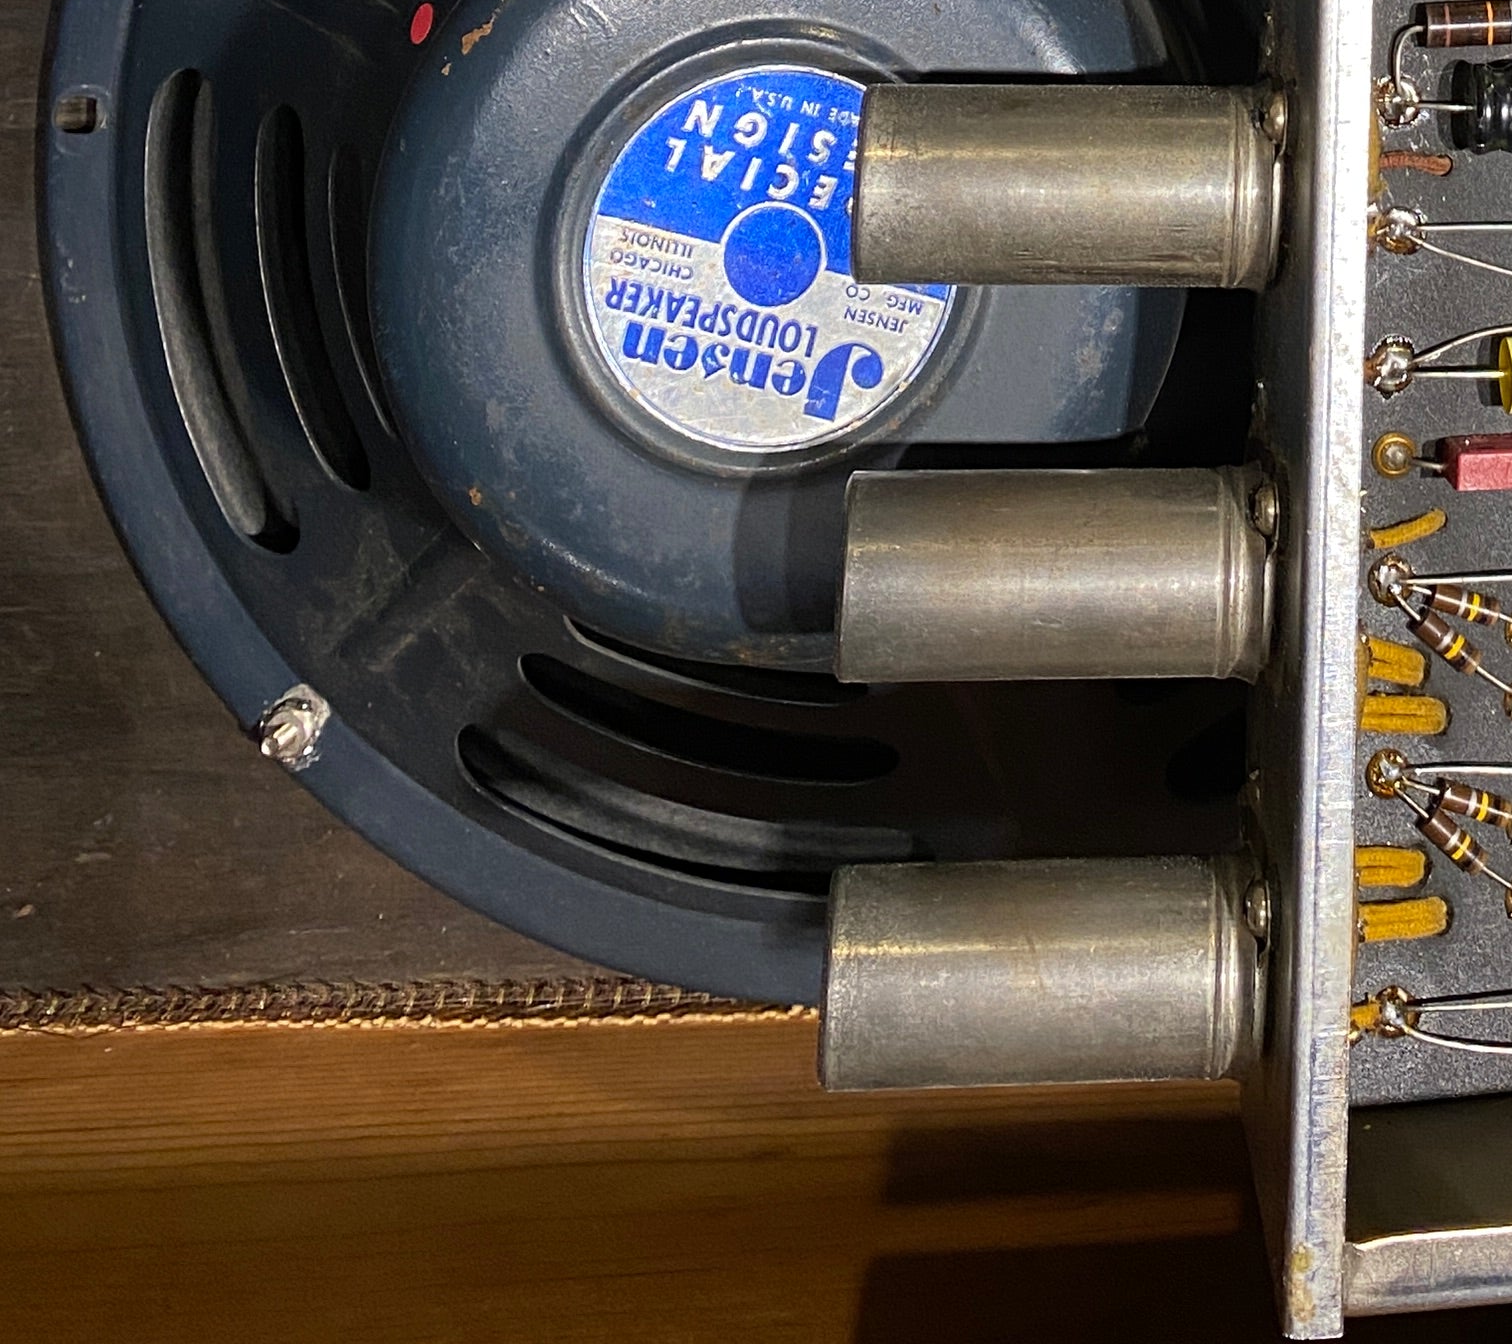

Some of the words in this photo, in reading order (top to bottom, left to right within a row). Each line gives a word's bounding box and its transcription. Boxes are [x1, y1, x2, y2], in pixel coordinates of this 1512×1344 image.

[680, 99, 858, 172] SIGN
[799, 99, 821, 118] IN
[827, 106, 860, 128] ADE
[663, 135, 853, 217] ECIAL
[609, 247, 695, 281] CHICAGO
[618, 225, 695, 259] ILLINOIS
[604, 275, 821, 359] LOUDSPEAKER
[843, 305, 909, 334] JENSEN
[621, 319, 884, 423] Jensen
